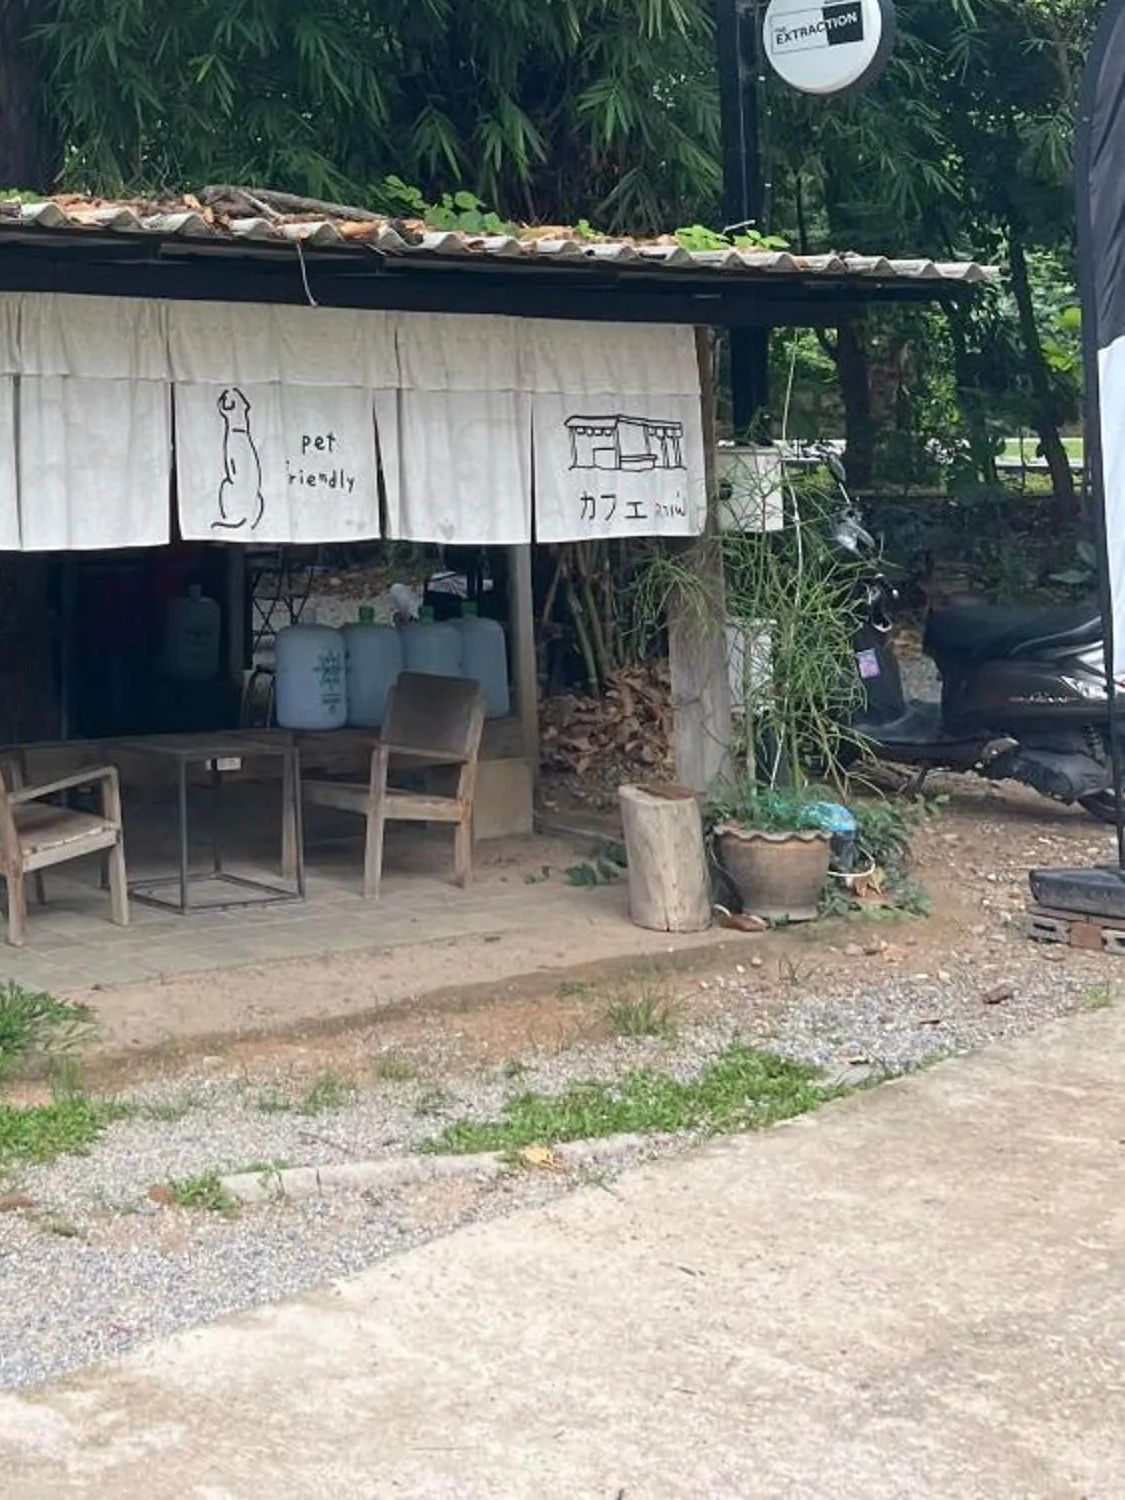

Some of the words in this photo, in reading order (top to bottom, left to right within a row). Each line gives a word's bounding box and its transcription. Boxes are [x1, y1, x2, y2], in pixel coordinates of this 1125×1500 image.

[775, 11, 858, 45] EXTRACTION
[301, 431, 336, 455] pet
[285, 459, 356, 494] riendly
